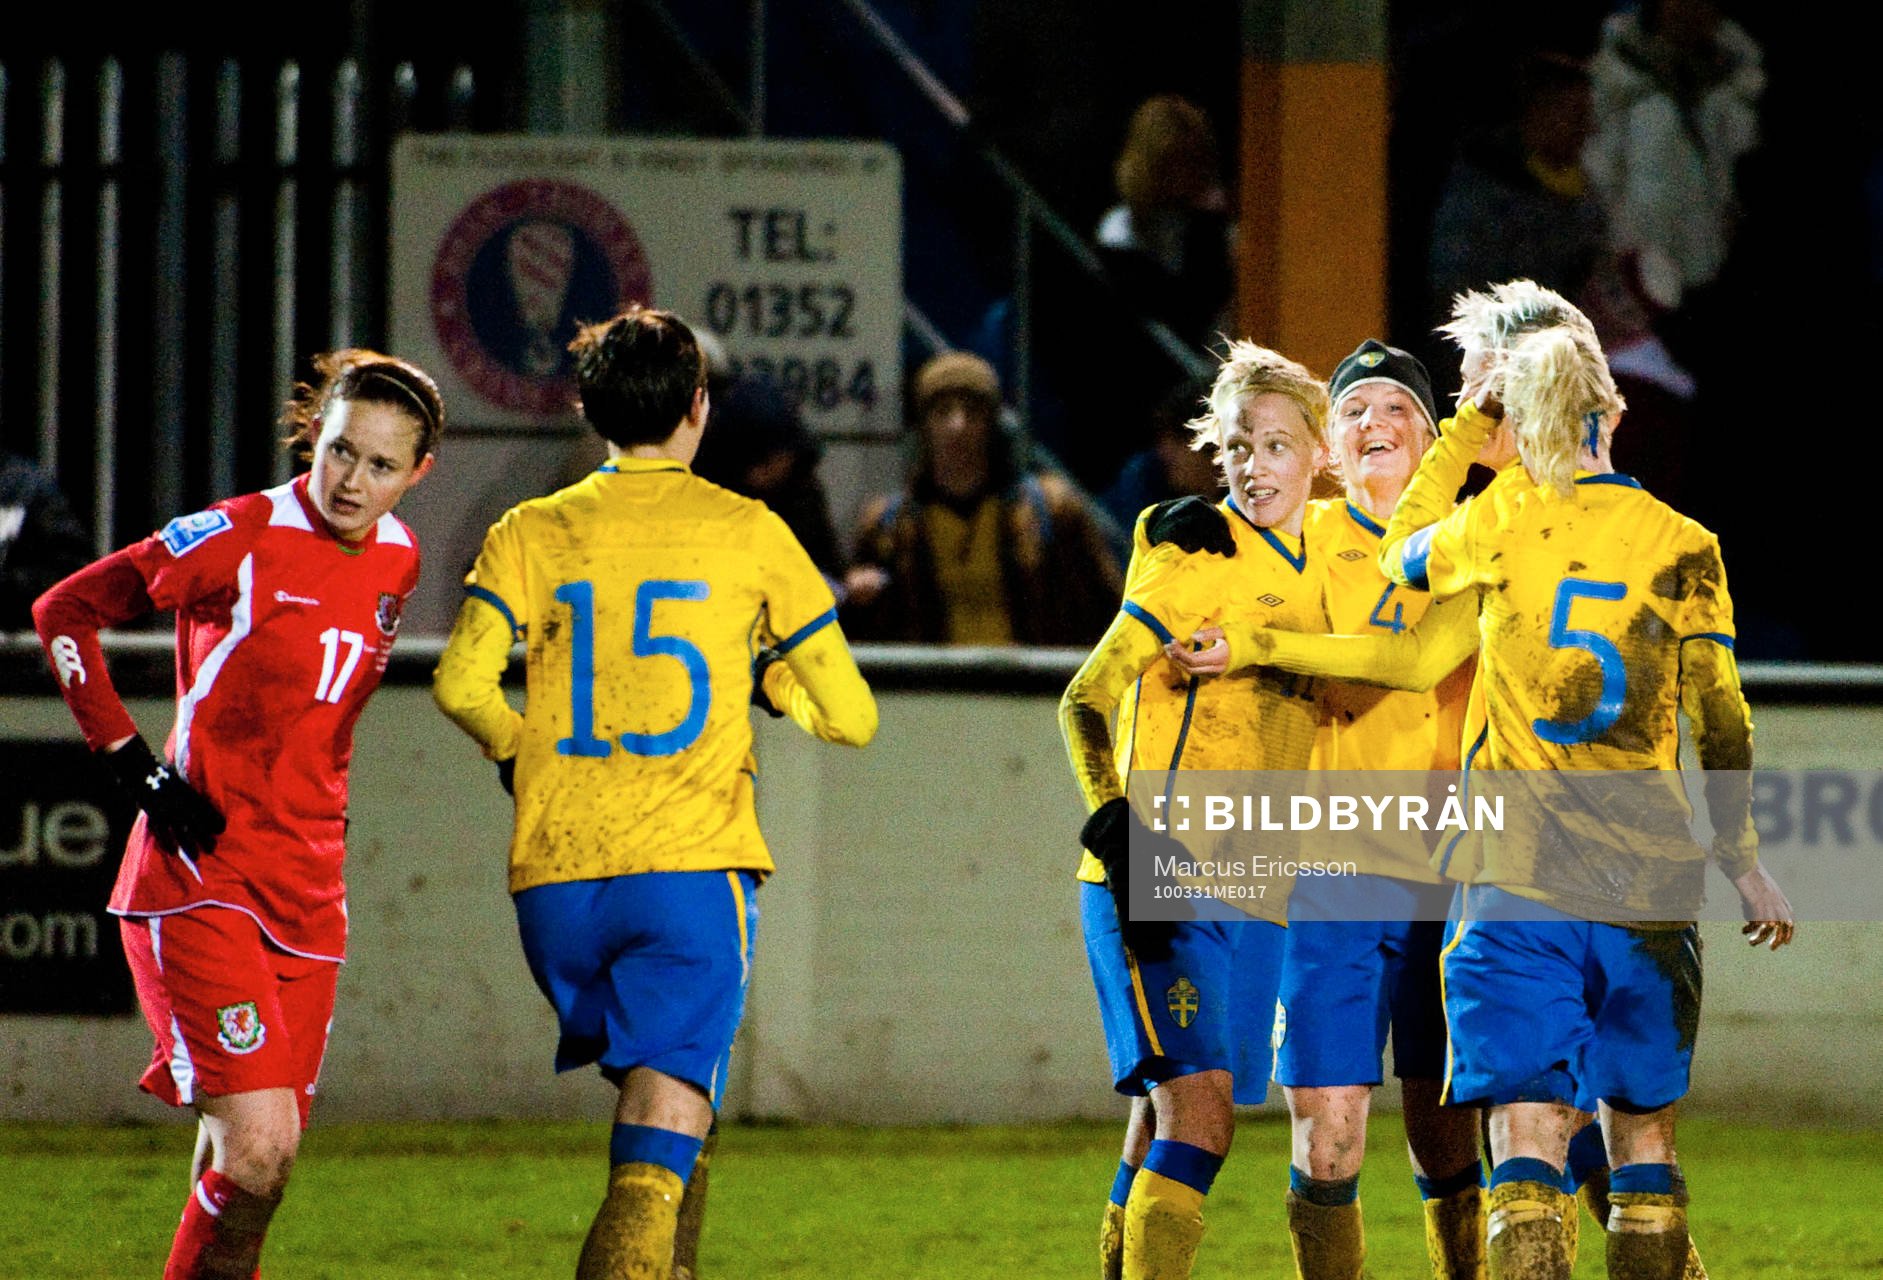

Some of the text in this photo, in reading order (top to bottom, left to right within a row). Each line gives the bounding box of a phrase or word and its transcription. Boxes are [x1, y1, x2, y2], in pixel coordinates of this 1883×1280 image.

[728, 208, 836, 262] TEL:
[706, 281, 855, 337] 01352
[1370, 582, 1406, 634] 4
[314, 627, 364, 704] 17
[554, 580, 712, 757] 15
[1533, 577, 1628, 745] 5
[0, 912, 97, 957] om
